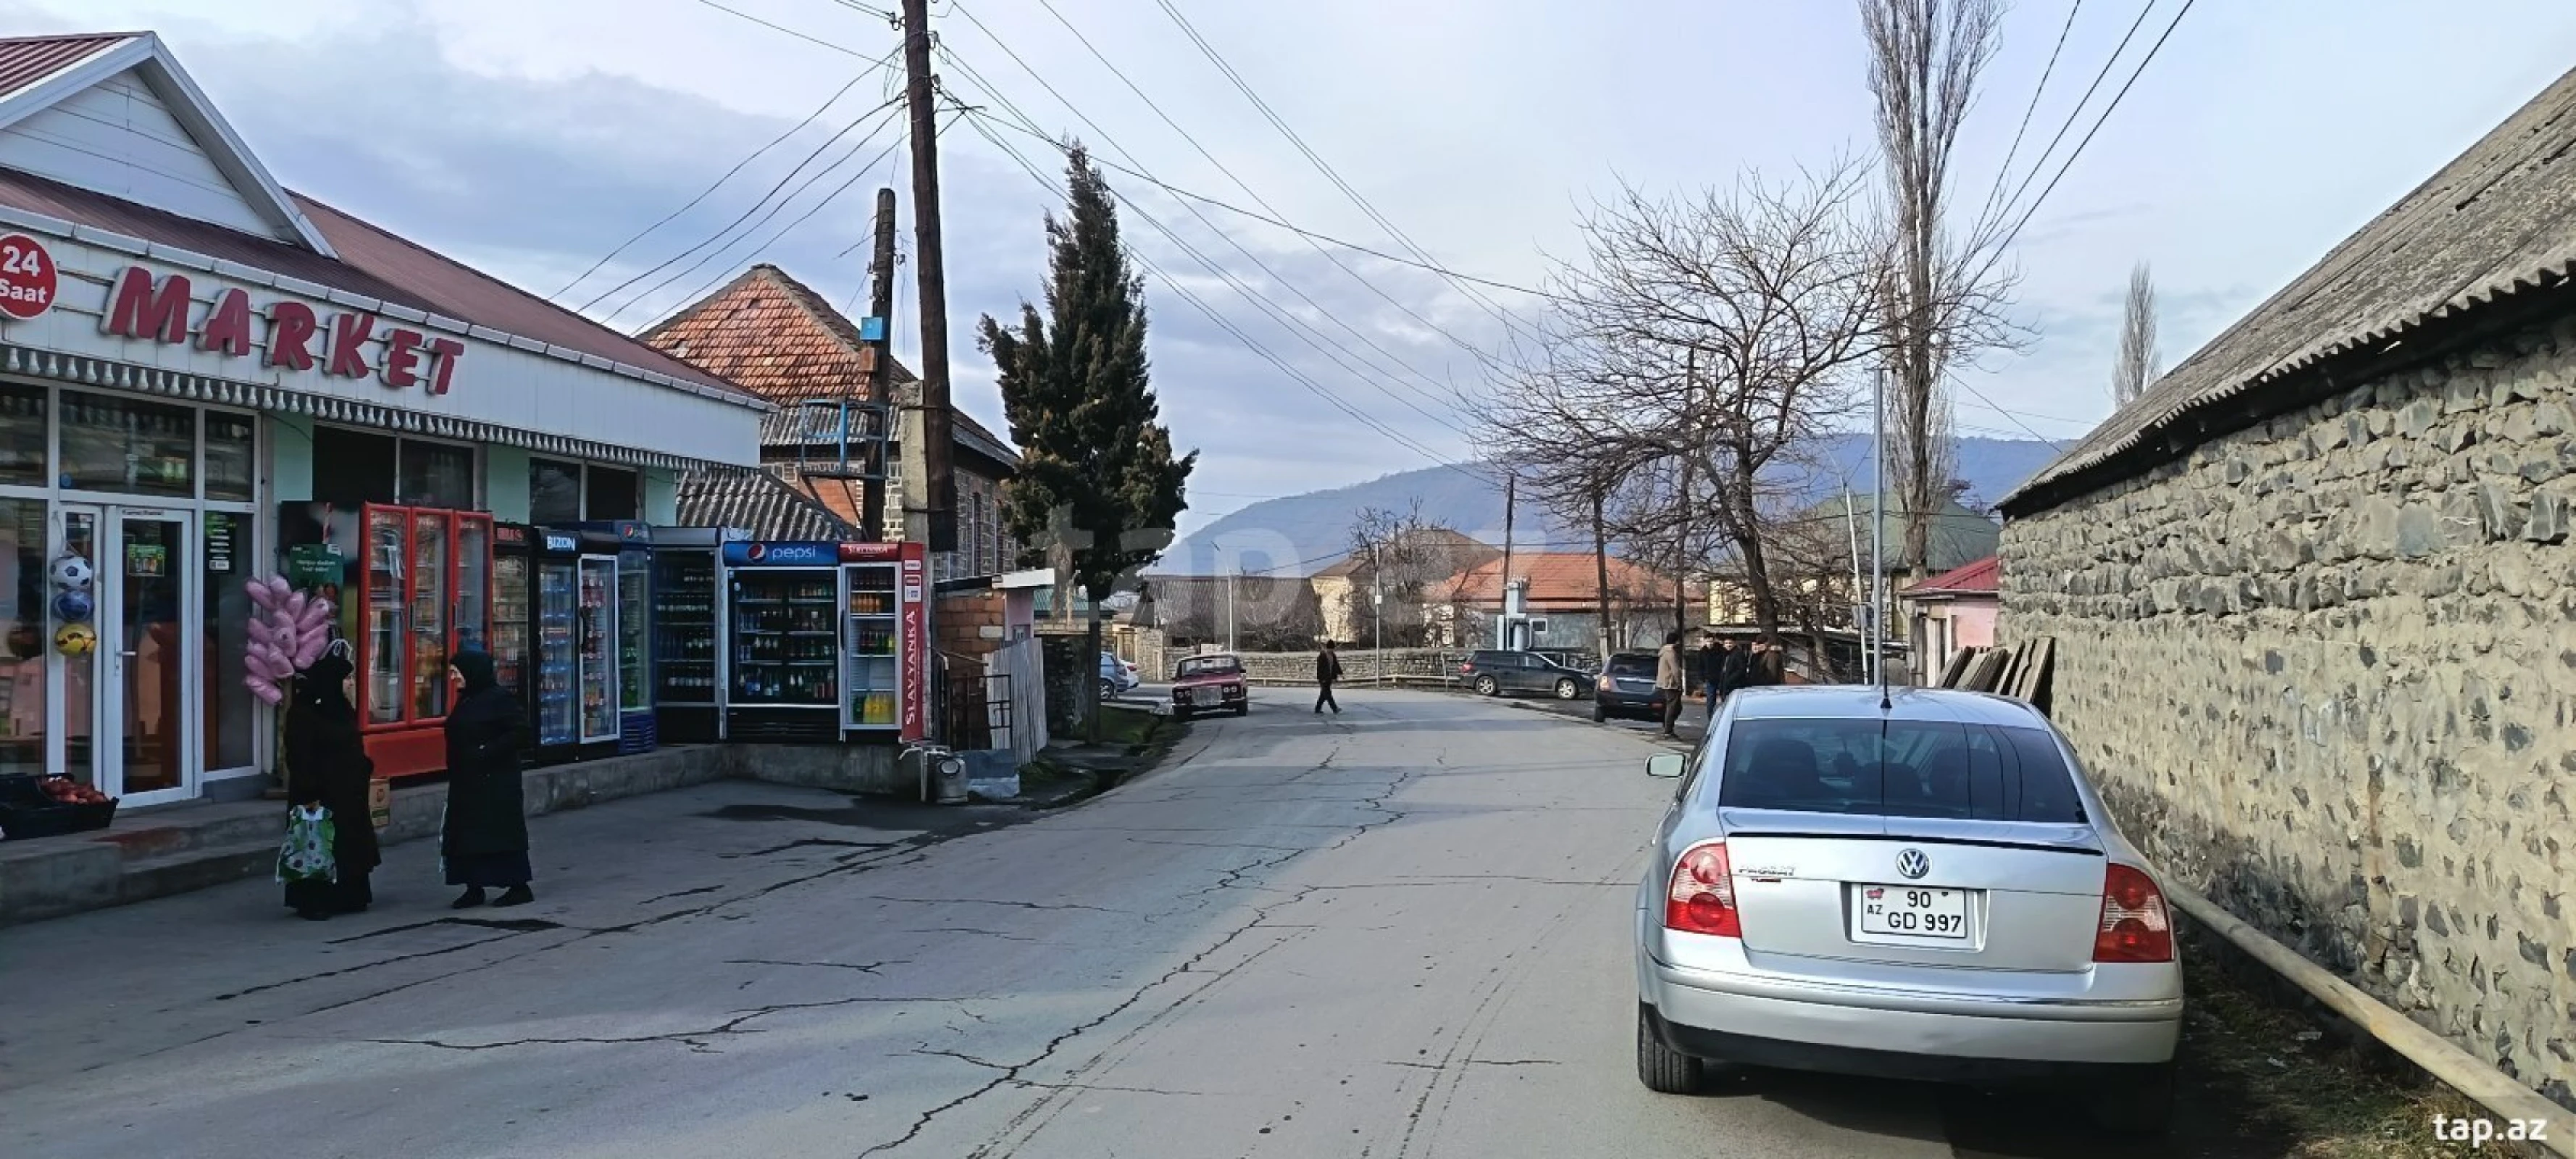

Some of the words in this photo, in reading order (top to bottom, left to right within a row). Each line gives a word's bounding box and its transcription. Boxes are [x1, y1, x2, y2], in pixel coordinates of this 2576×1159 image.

[3, 245, 41, 277] 24
[0, 278, 47, 303] Saat
[100, 267, 464, 395] MARKET
[772, 545, 816, 560] pepsi
[906, 610, 916, 724] SLAVYANKA
[1867, 904, 1883, 915] AZ
[1907, 890, 1932, 908] 90
[1888, 912, 1917, 929] GD
[1925, 913, 1962, 933] 997
